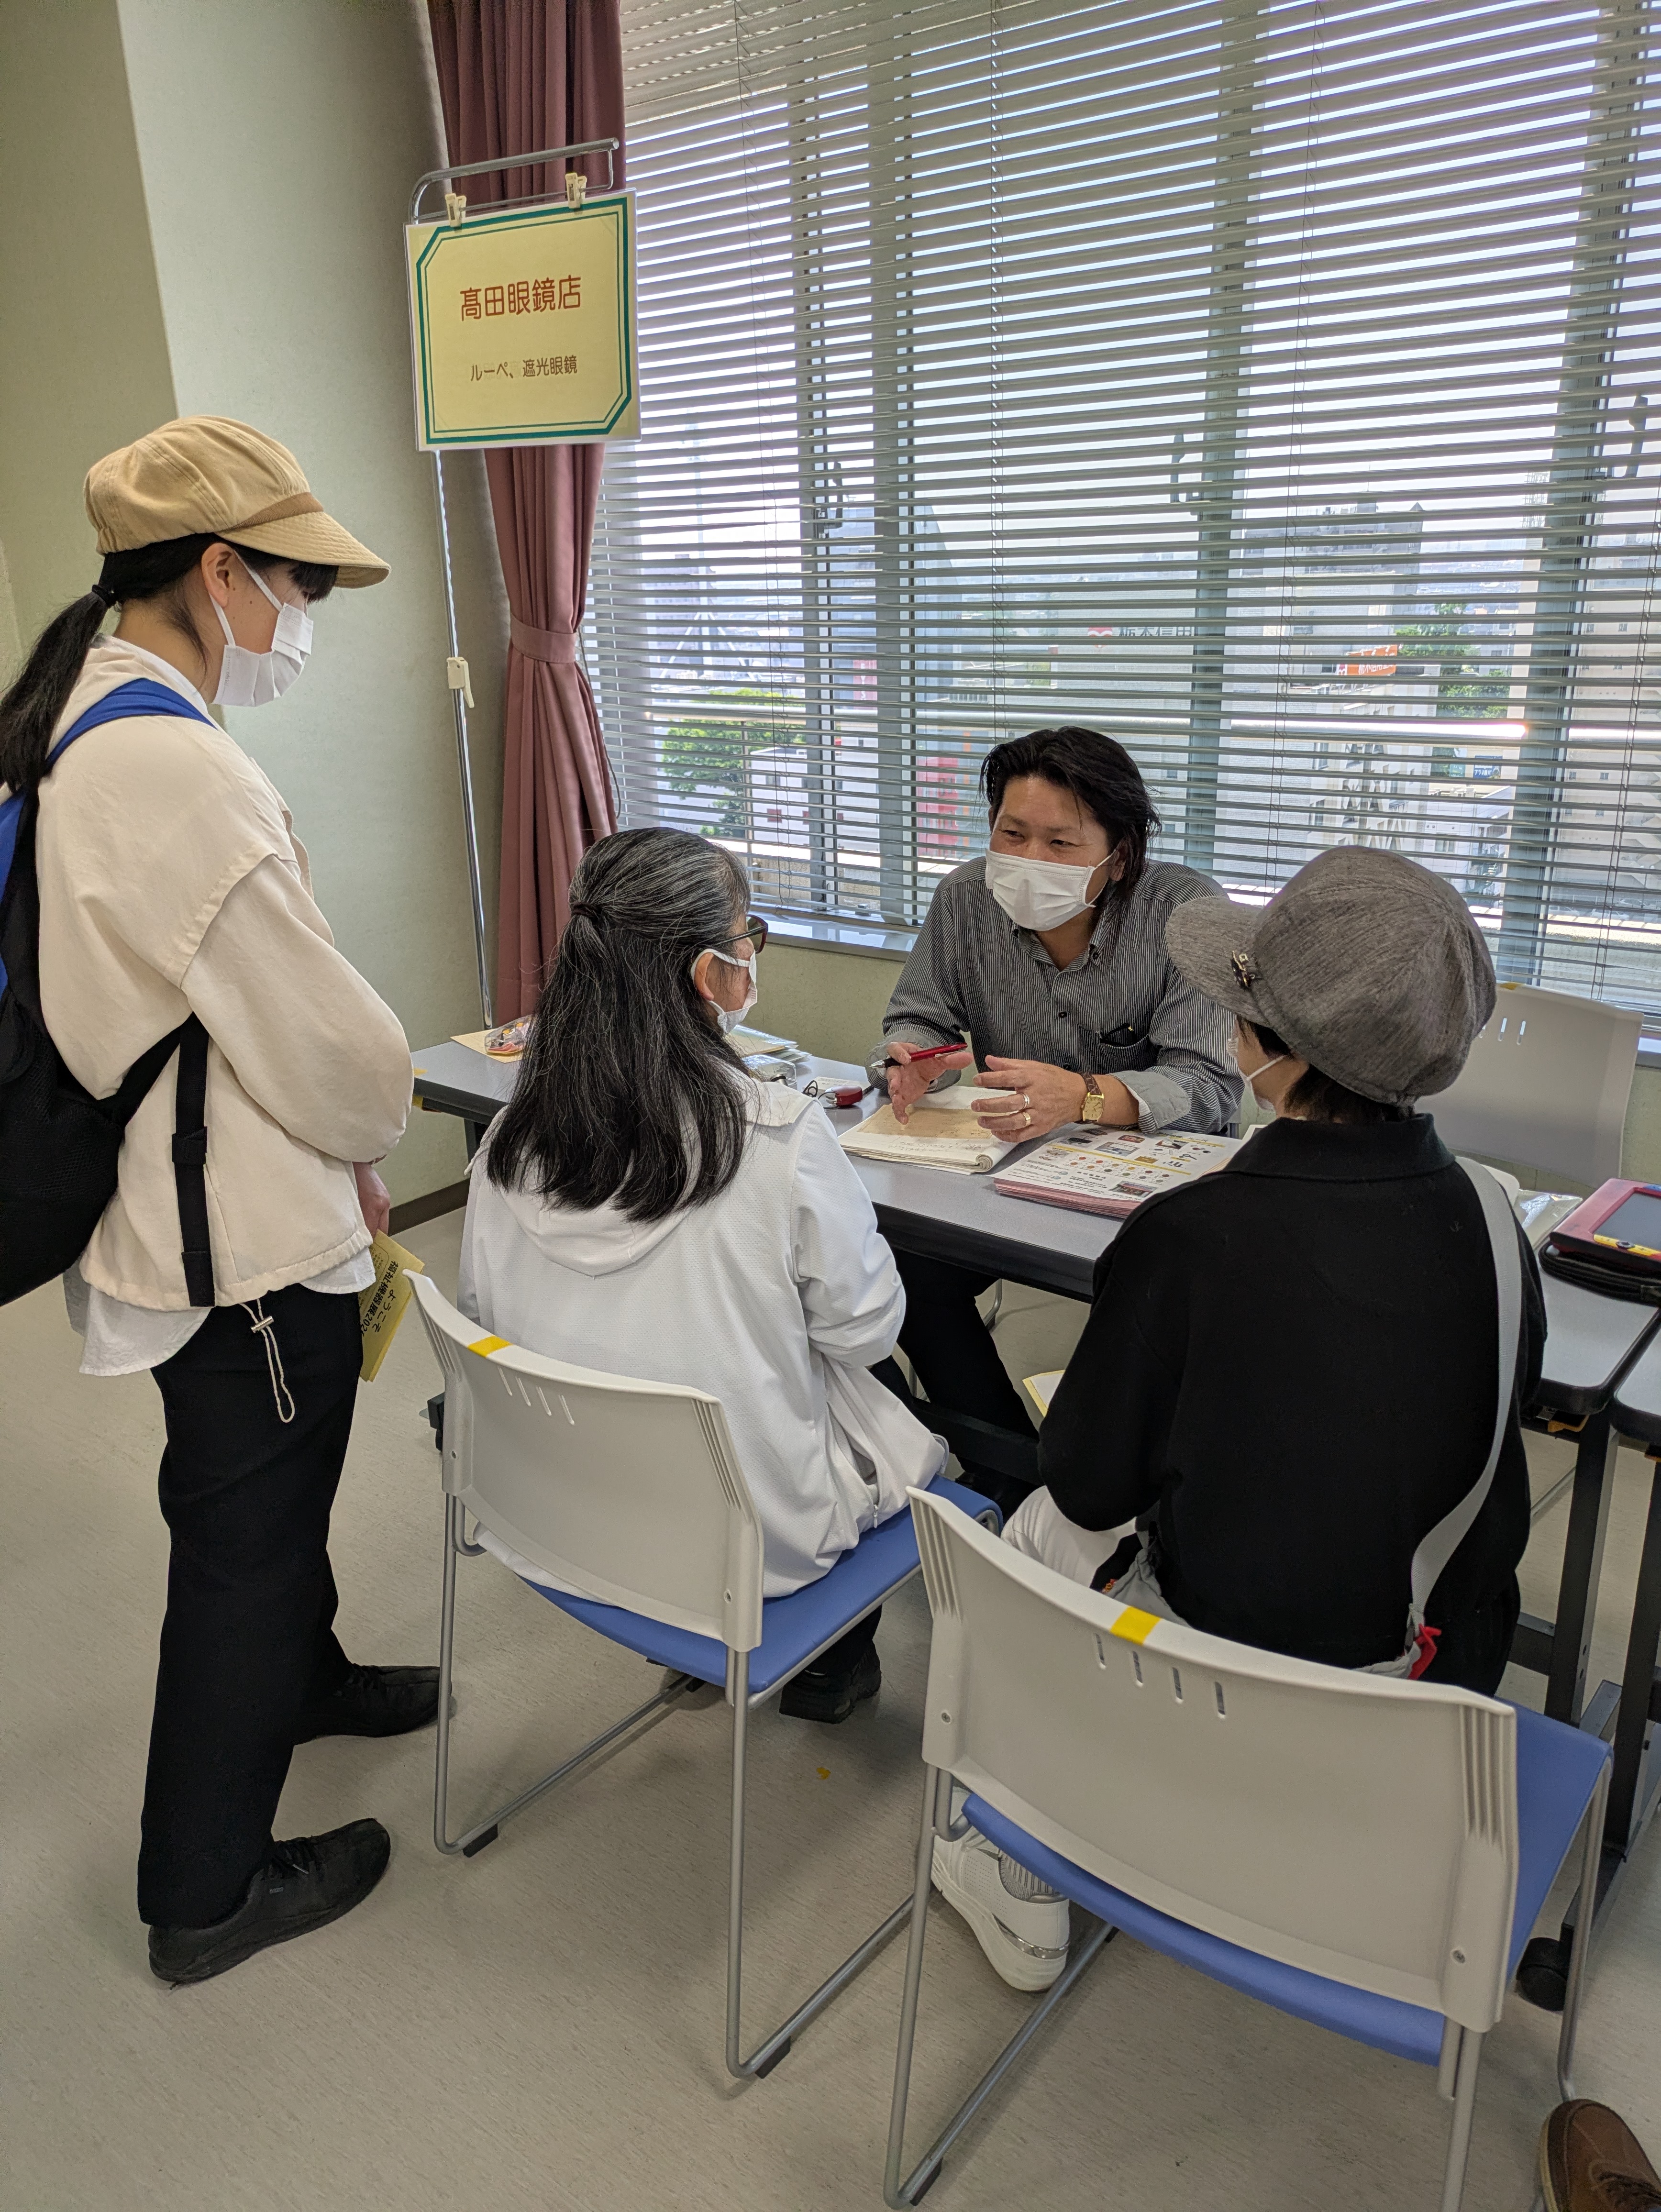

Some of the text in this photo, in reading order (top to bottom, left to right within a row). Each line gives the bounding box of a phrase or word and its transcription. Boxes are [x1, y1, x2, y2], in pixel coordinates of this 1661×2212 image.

[470, 354, 578, 381] ルーペ、遮光眼鏡
[360, 1260, 399, 1338] 福祉機器展202
[372, 1289, 397, 1333] ようこそ
